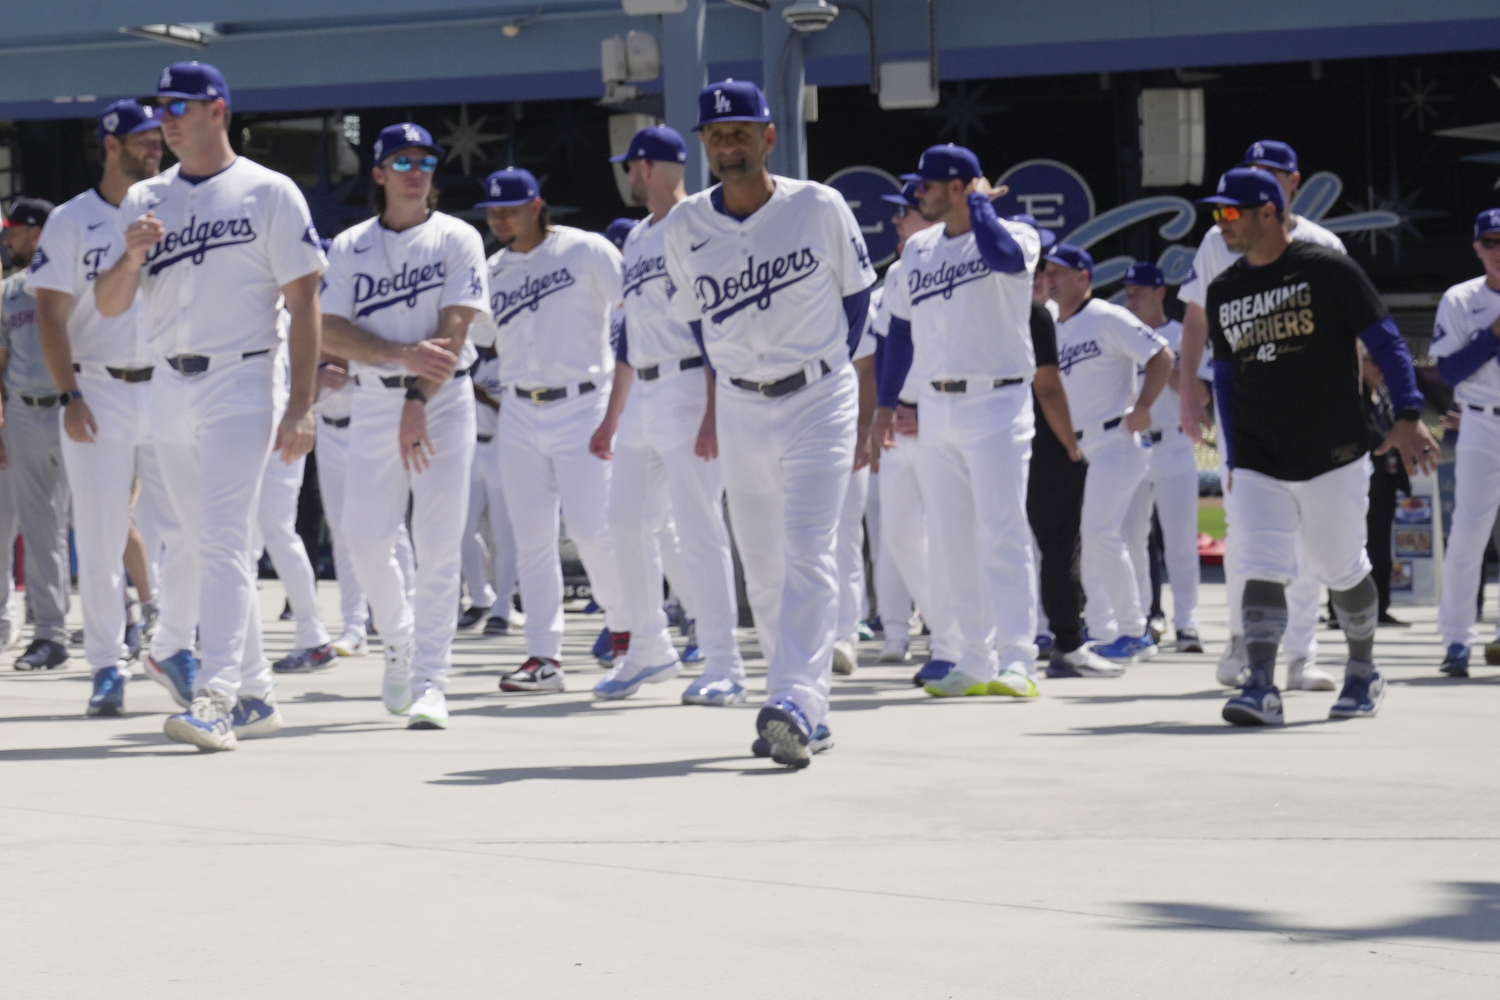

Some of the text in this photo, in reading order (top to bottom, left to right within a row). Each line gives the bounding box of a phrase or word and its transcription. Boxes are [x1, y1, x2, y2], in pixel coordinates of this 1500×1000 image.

[352, 261, 445, 319] Dodger
[489, 267, 575, 327] Dodgers
[695, 246, 819, 324] Dodgers
[907, 257, 992, 306] Dodgers
[1218, 281, 1312, 328] BREAKING
[1058, 340, 1102, 375] dgers
[1256, 342, 1277, 363] 42
